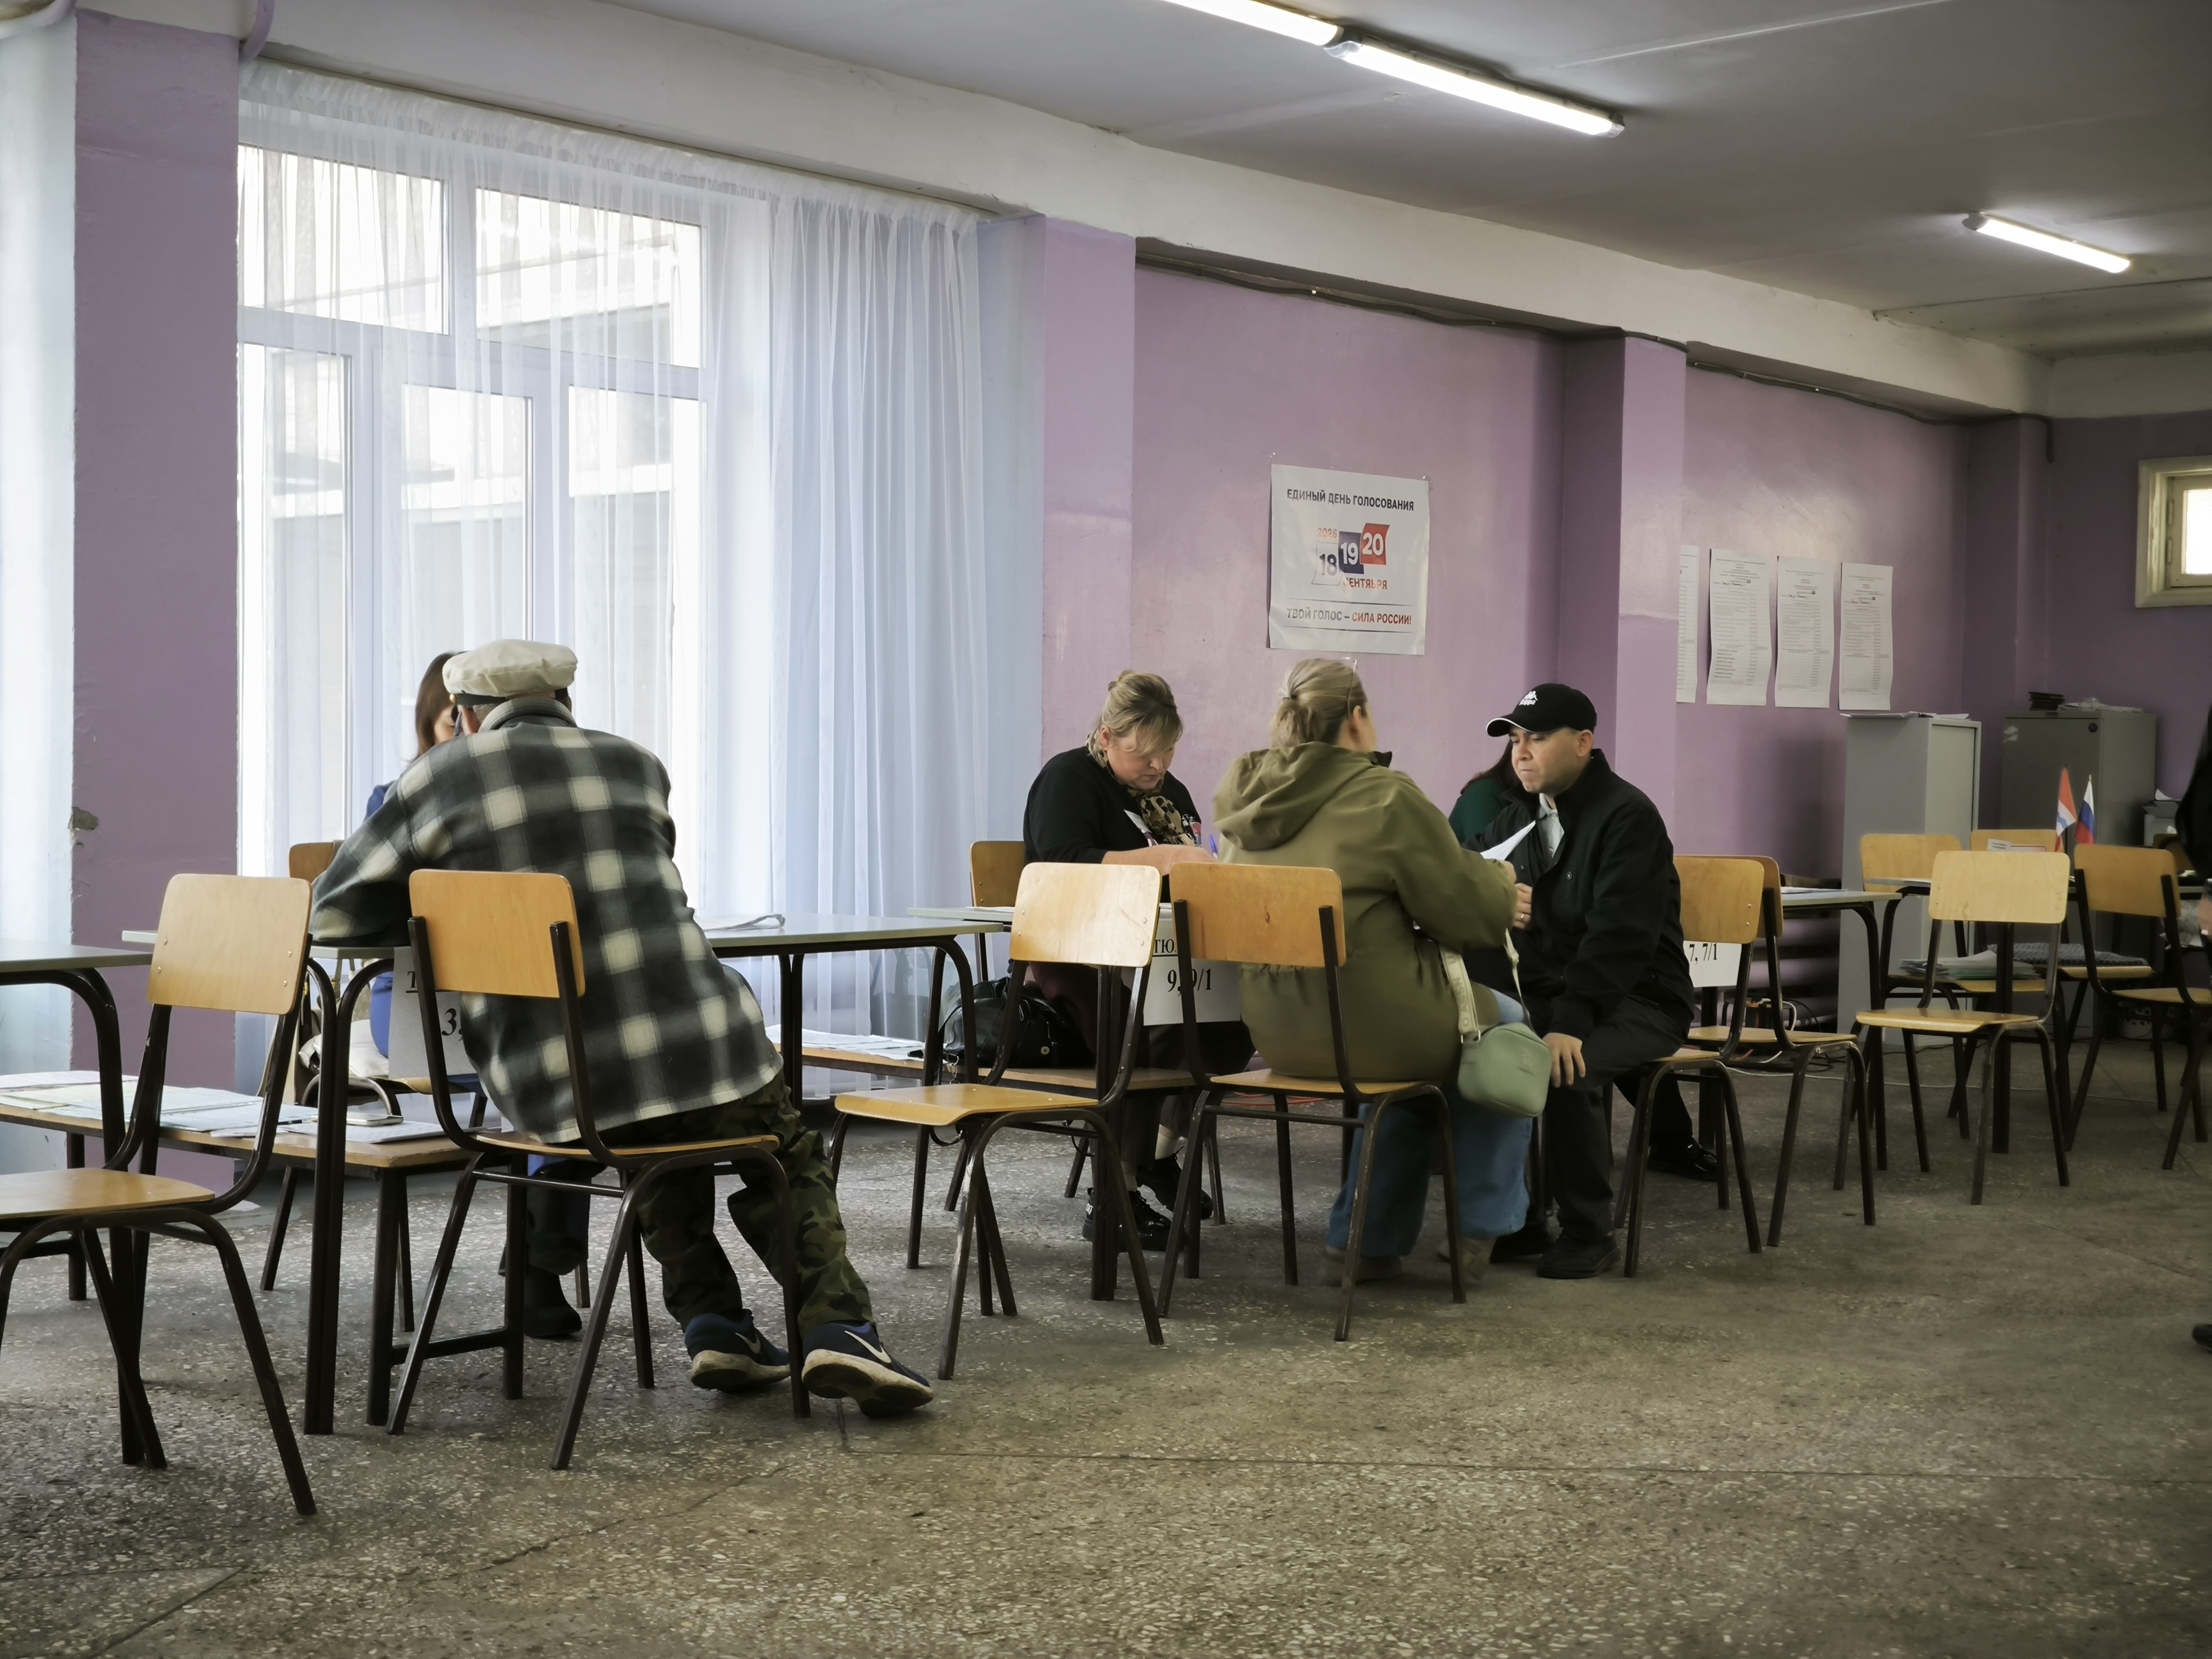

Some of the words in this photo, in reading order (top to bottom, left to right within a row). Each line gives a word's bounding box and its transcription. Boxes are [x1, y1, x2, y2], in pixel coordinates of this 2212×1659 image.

[1287, 489, 1326, 502] ЕДИНЫЙ
[1327, 493, 1351, 505] ДЕНЬ
[1353, 495, 1414, 511] ГОЛОСОВАНИЯ
[1319, 553, 1338, 577] 18
[1340, 542, 1359, 565] 19
[1362, 532, 1384, 556] 20
[1286, 606, 1311, 619] ТВОЙ
[1313, 610, 1343, 621] ГОЛОС
[1352, 612, 1375, 623] СИЛА
[1377, 613, 1412, 625] РОССИИ!
[1689, 943, 1698, 966] 7,
[1702, 942, 1718, 961] 7/1
